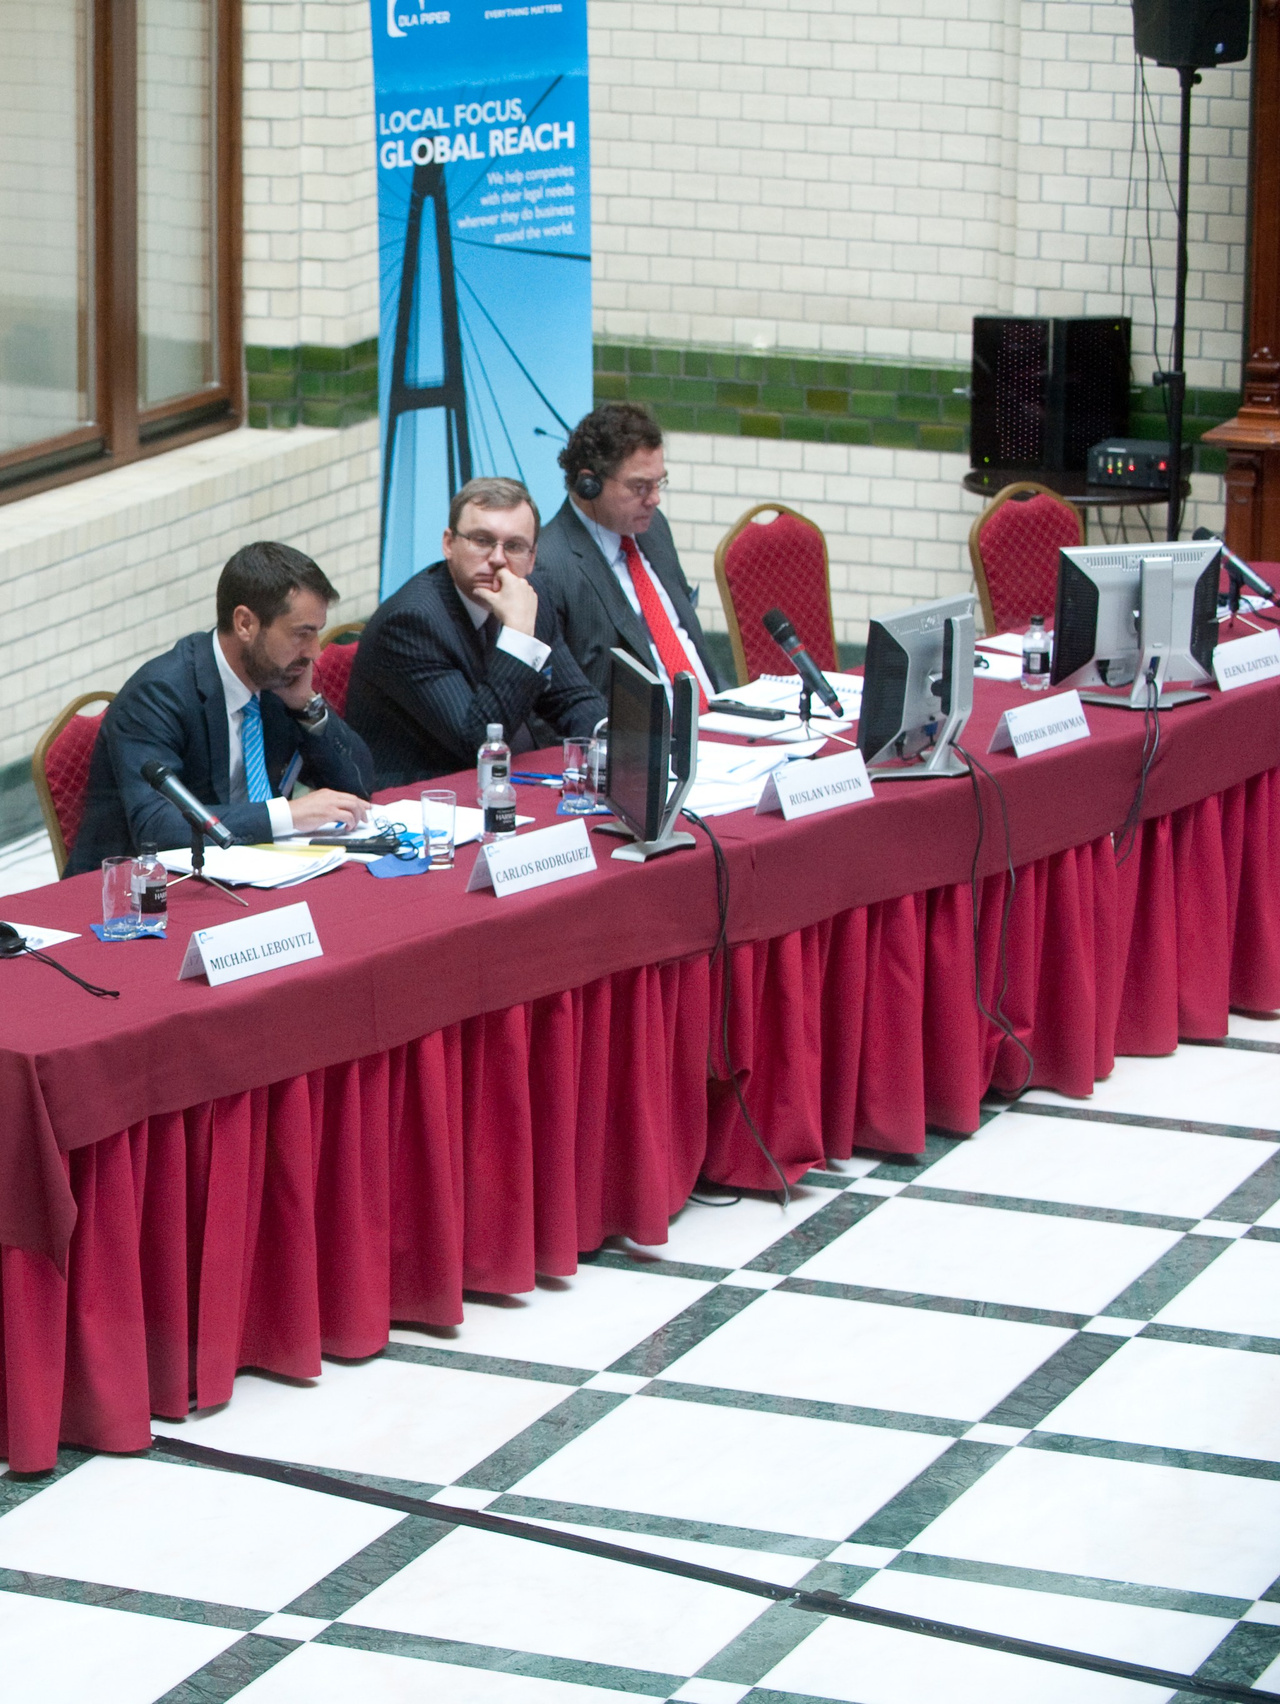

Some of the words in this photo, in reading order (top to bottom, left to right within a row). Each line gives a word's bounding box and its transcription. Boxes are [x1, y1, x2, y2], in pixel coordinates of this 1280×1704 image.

[398, 14, 419, 27] DLA
[420, 11, 451, 25] PIPER
[484, 7, 529, 19] EVERYTHING
[531, 4, 563, 15] MATTERS
[380, 107, 451, 135] LOCAL
[455, 98, 526, 127] FOCUS,
[380, 132, 485, 169] GLOBAL
[489, 121, 575, 158] REACH
[487, 172, 503, 185] We
[505, 169, 524, 186] help
[525, 164, 575, 182] companies
[481, 192, 500, 206] with
[501, 189, 523, 204] their
[524, 185, 544, 204] legal
[545, 183, 575, 198] needs
[458, 215, 499, 228] wherever
[500, 210, 520, 226] they
[521, 207, 534, 220] do
[535, 205, 575, 219] business
[494, 227, 525, 244] around
[525, 226, 541, 239] the
[1223, 663, 1246, 678] ELENA
[1246, 654, 1279, 672] ZAITSEVA
[1013, 728, 1048, 746] RODERIK
[1047, 715, 1086, 736] BOUWMAN
[789, 786, 824, 806] RUSLAN
[824, 777, 862, 796] VASUTIN
[495, 863, 535, 883] CARLOS
[534, 846, 590, 873] RODRIGUEZ
[210, 947, 260, 972] MICHAEL
[260, 932, 315, 957] LEBOVITZ
